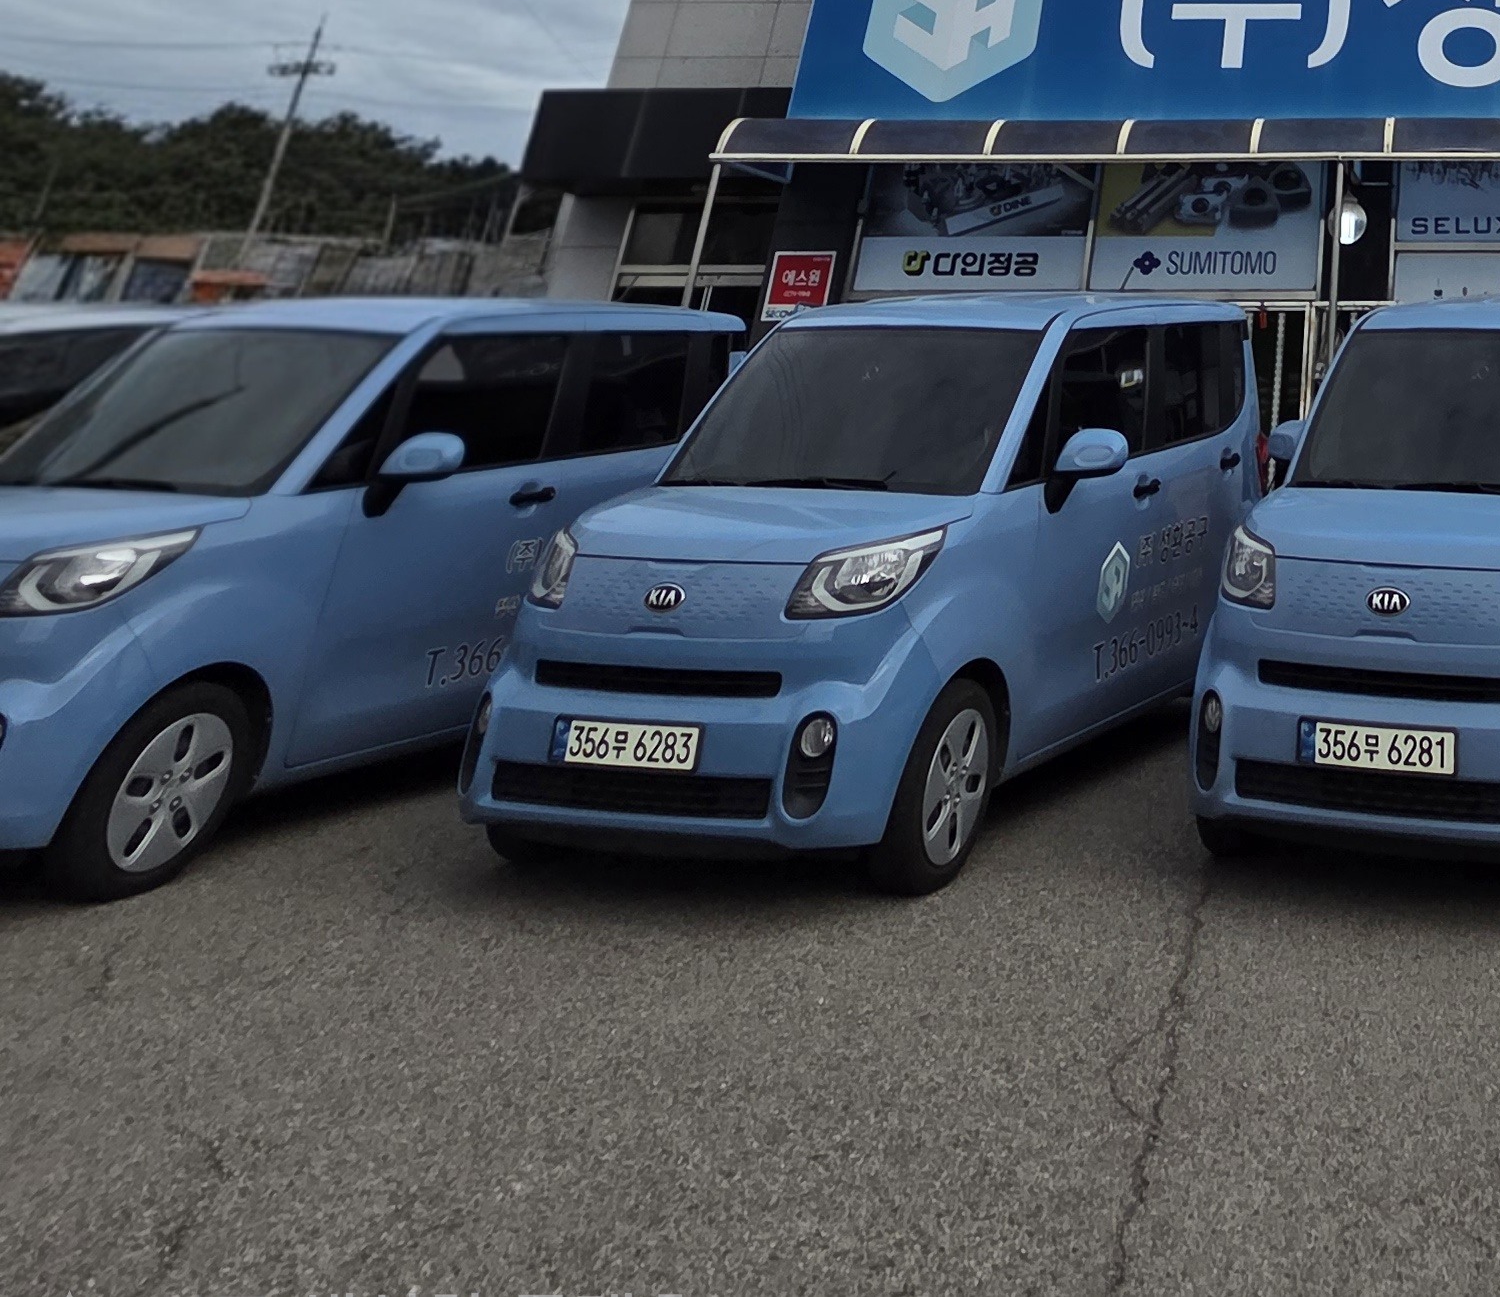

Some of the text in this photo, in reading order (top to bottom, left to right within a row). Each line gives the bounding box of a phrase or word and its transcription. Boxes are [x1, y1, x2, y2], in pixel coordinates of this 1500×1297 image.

[932, 252, 1040, 277] 다인정공
[1165, 250, 1277, 276] SUMITOMO
[781, 268, 821, 287] 에스원
[1371, 593, 1401, 610] KIA
